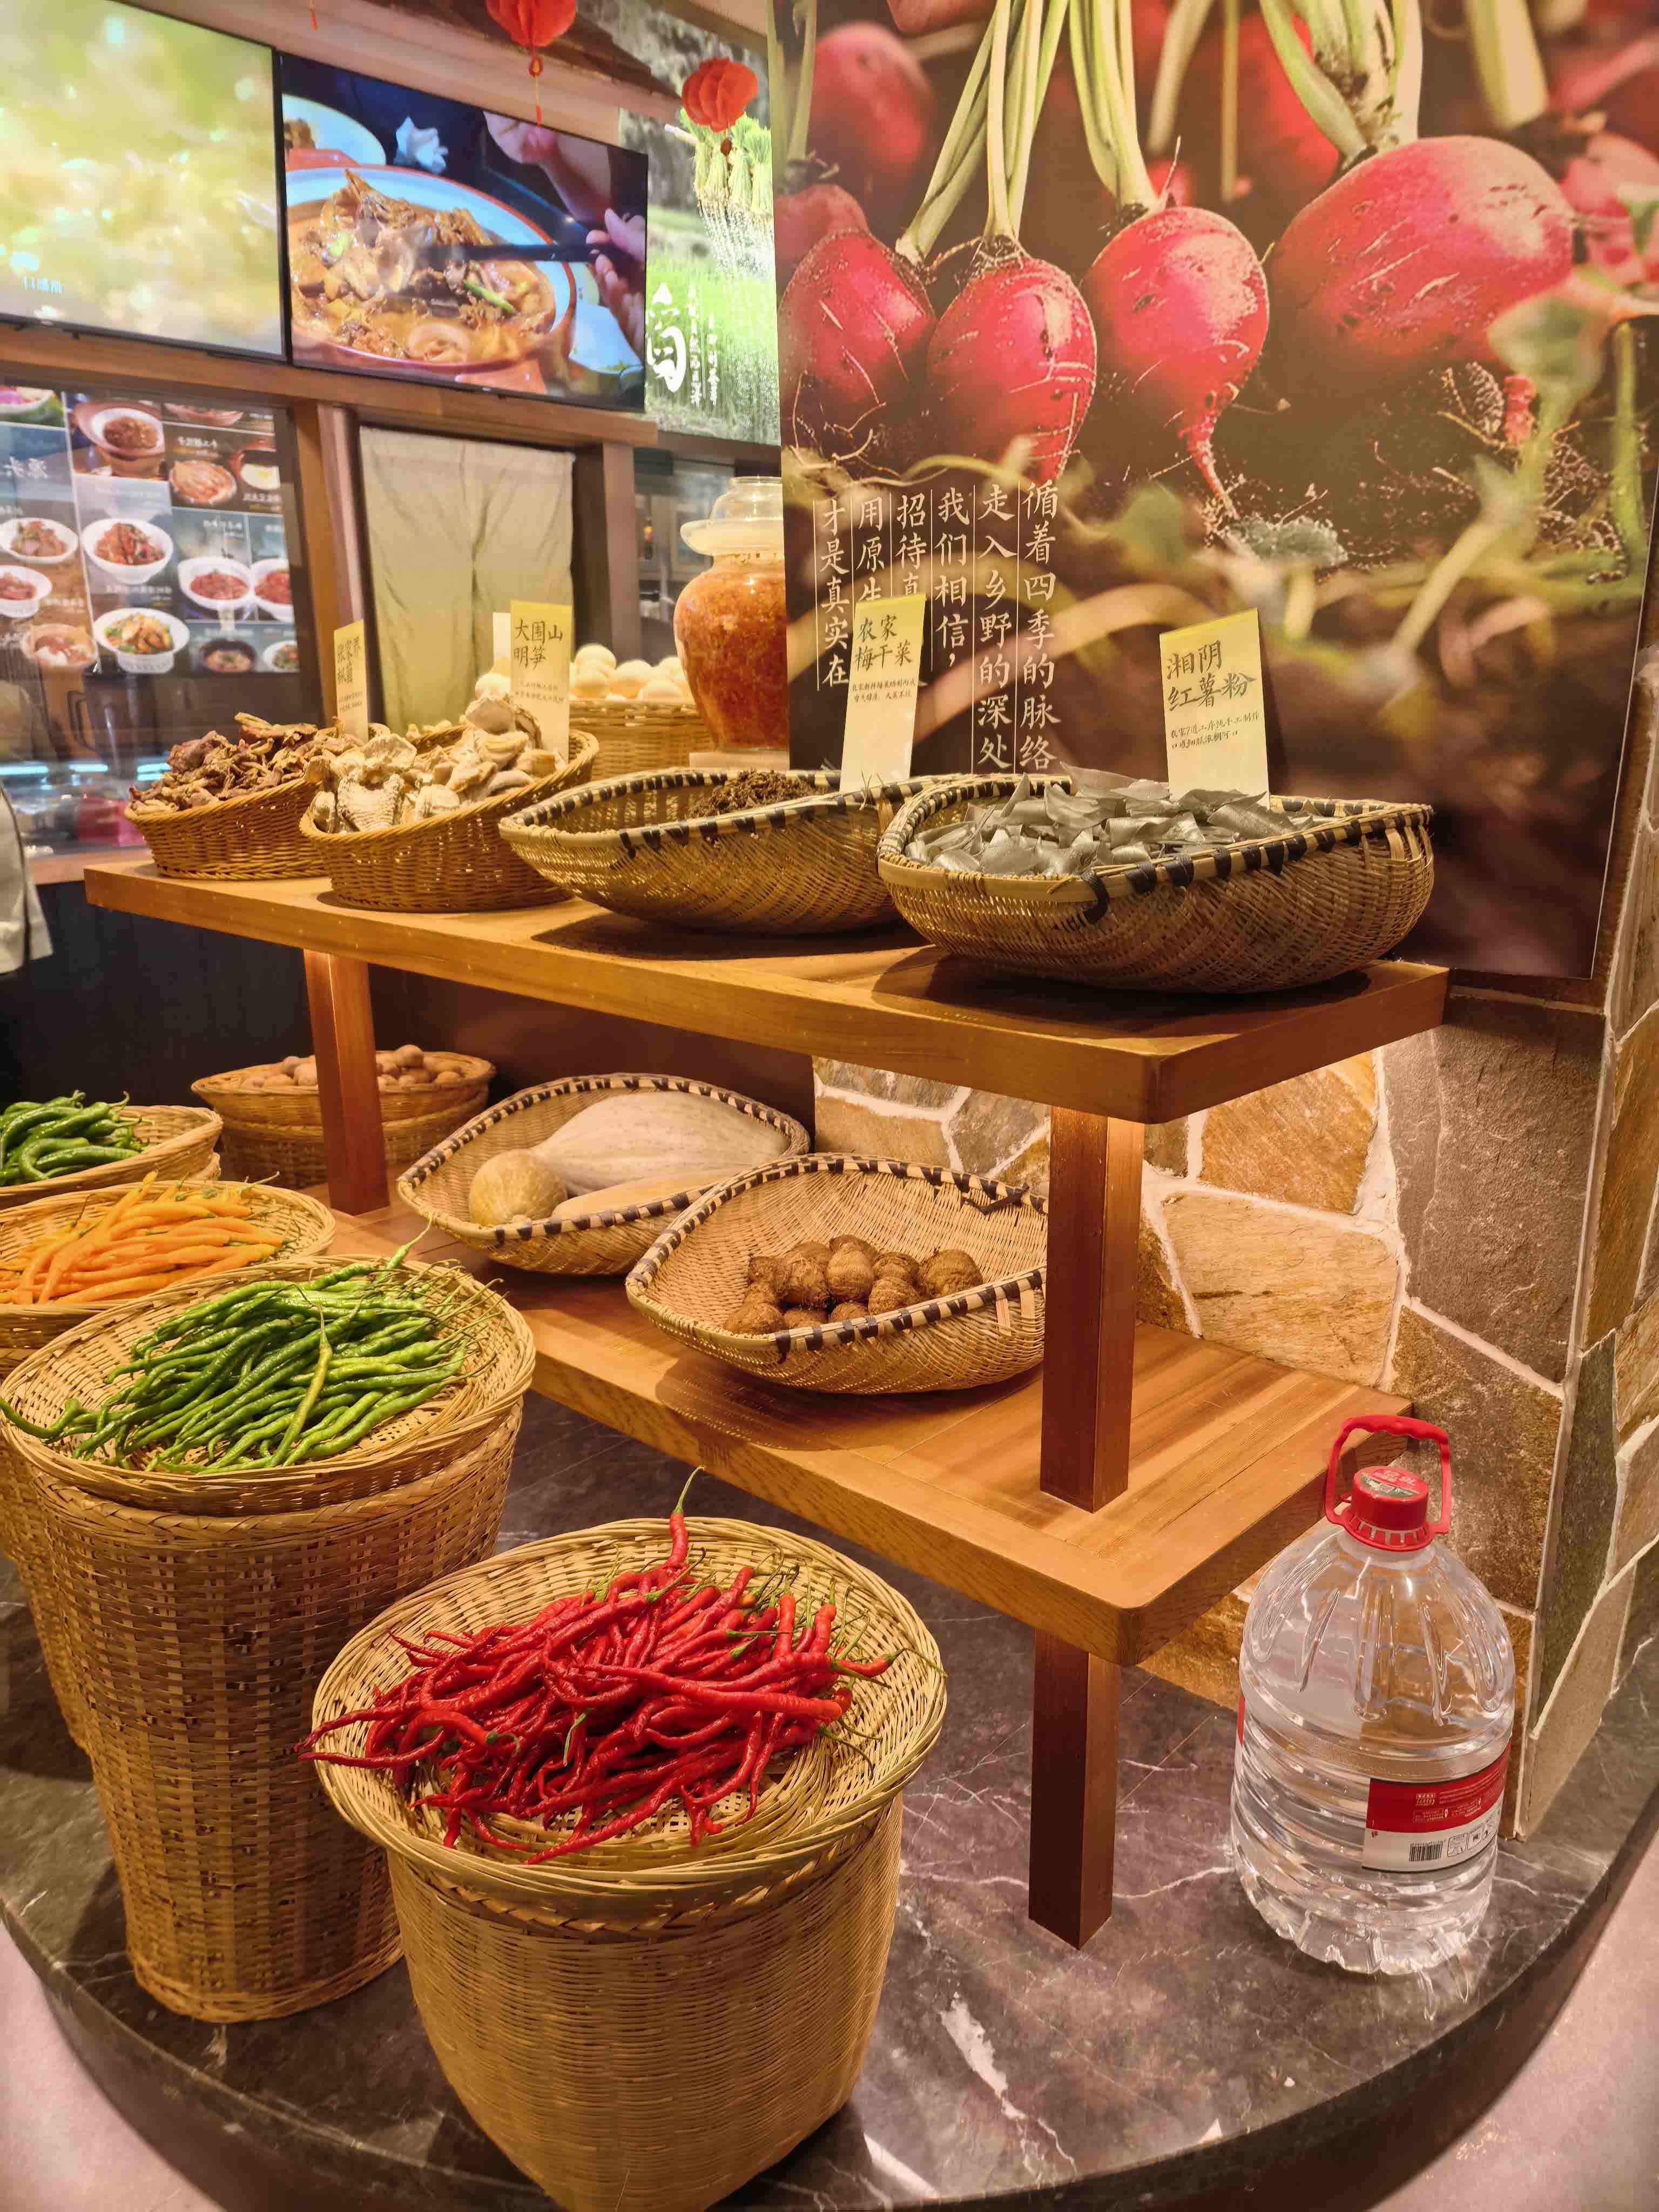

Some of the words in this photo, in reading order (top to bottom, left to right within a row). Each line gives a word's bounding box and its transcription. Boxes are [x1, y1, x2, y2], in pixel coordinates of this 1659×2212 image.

[819, 498, 850, 687] 才是真实在
[515, 618, 563, 644] 大围山
[858, 613, 898, 643] 农家
[977, 484, 1018, 769] 走入乡野的深处
[1020, 479, 1061, 771] 循着四季的脉络
[514, 645, 546, 670] 明笋
[854, 640, 913, 672] 梅干菜
[1166, 640, 1222, 680] 湘阴
[1168, 673, 1257, 711] 红薯粉
